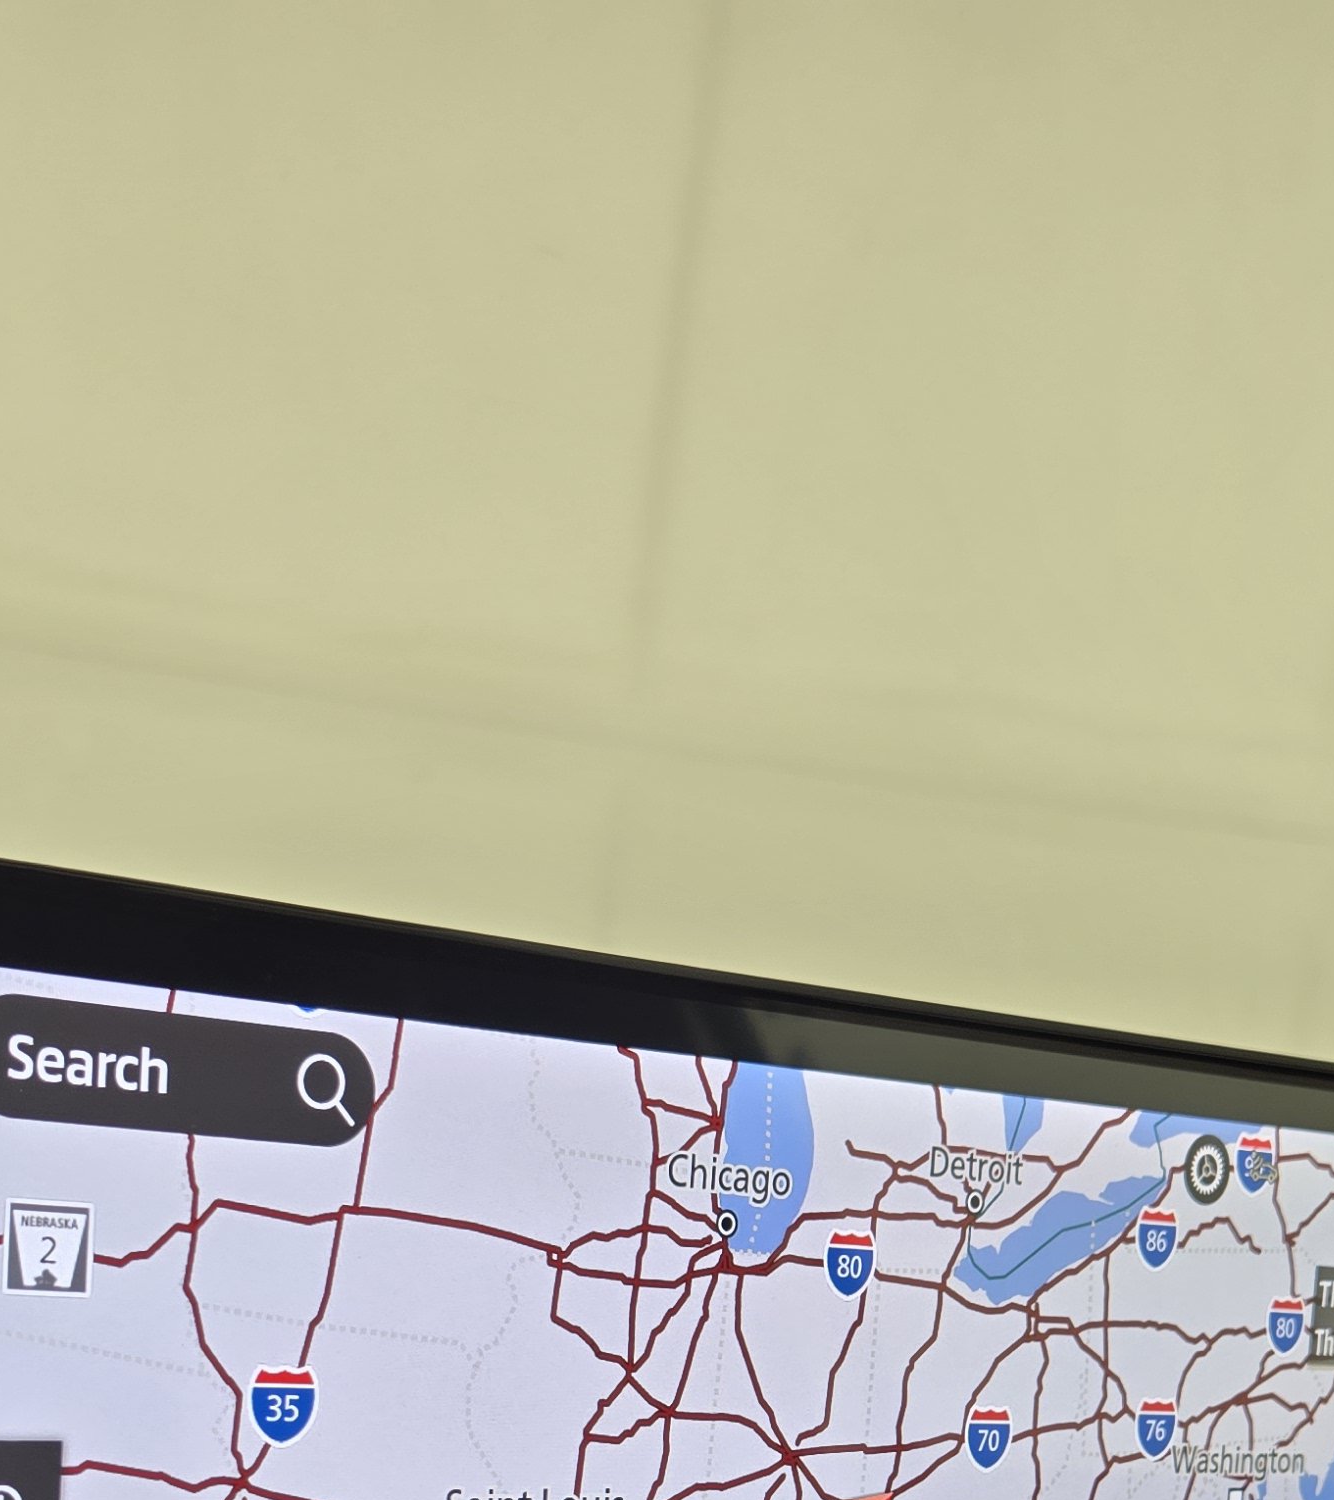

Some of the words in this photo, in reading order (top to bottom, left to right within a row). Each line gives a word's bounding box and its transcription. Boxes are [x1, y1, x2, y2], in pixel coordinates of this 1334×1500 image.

[6, 1034, 168, 1095] Search
[667, 1153, 792, 1202] Chicago
[929, 1147, 1024, 1187] Detroit
[21, 1214, 79, 1230] NEBRASKA
[40, 1236, 57, 1264] 2
[1145, 1231, 1168, 1252] 86
[835, 1256, 864, 1279] 80
[1276, 1317, 1296, 1339] 80
[266, 1393, 300, 1423] 35
[977, 1428, 1001, 1452] 70
[1145, 1420, 1167, 1442] 76
[1171, 1445, 1306, 1480] Washington
